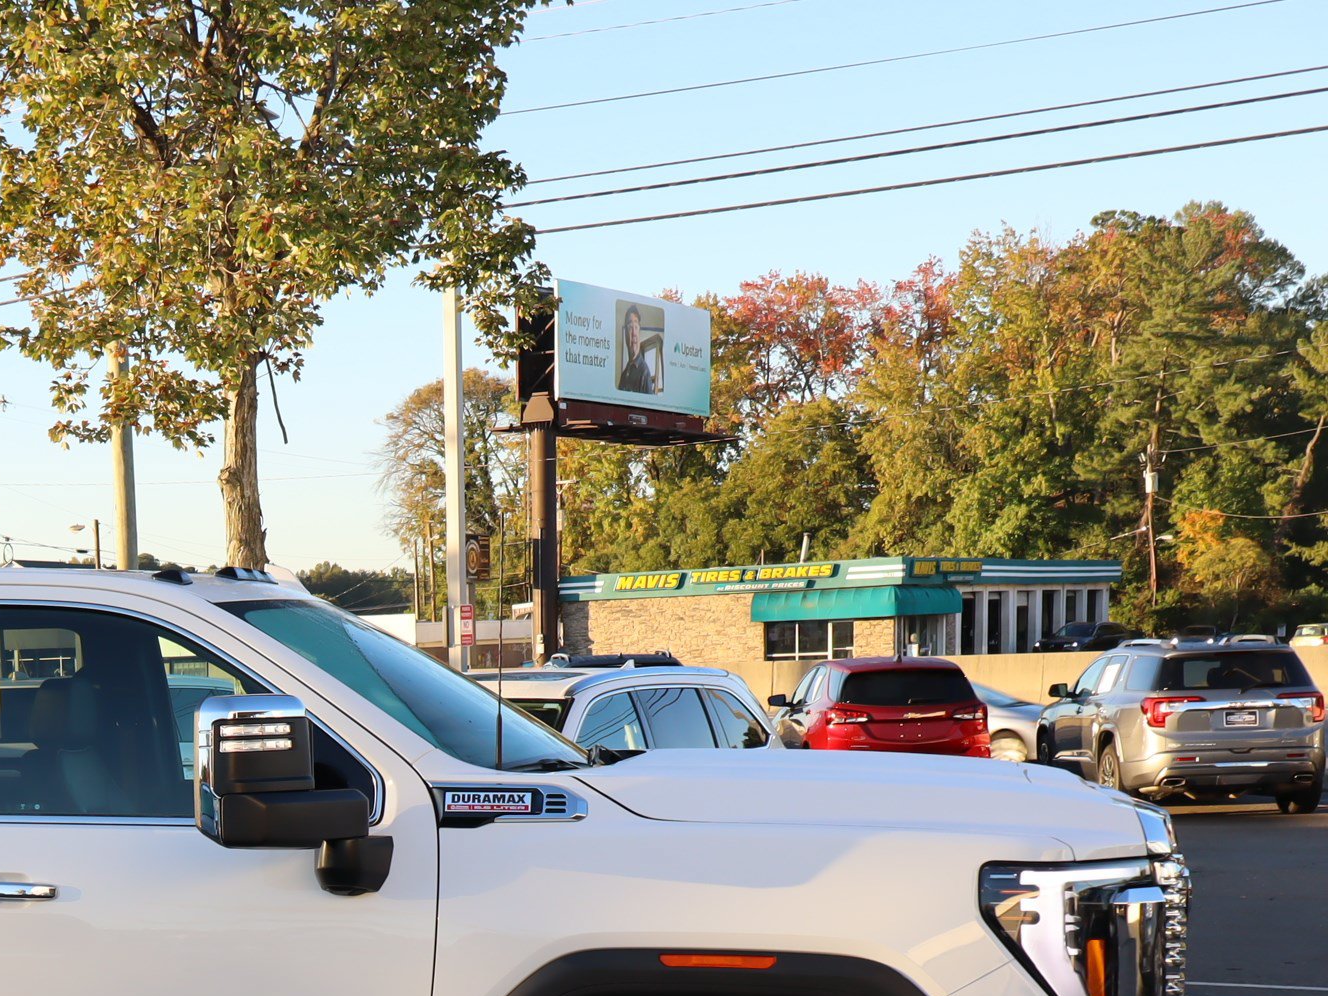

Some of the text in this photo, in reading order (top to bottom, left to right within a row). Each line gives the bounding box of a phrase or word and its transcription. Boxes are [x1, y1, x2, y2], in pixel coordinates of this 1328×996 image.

[565, 311, 603, 330] Money for
[565, 331, 611, 350] the moments
[565, 348, 607, 369] that matter
[681, 343, 703, 359] Upstart
[616, 564, 832, 590] MAVIS TIRES & BRAKES
[724, 582, 770, 591] DISCOUNT
[771, 580, 805, 588] PRICES
[451, 793, 526, 804] DURAMAX
